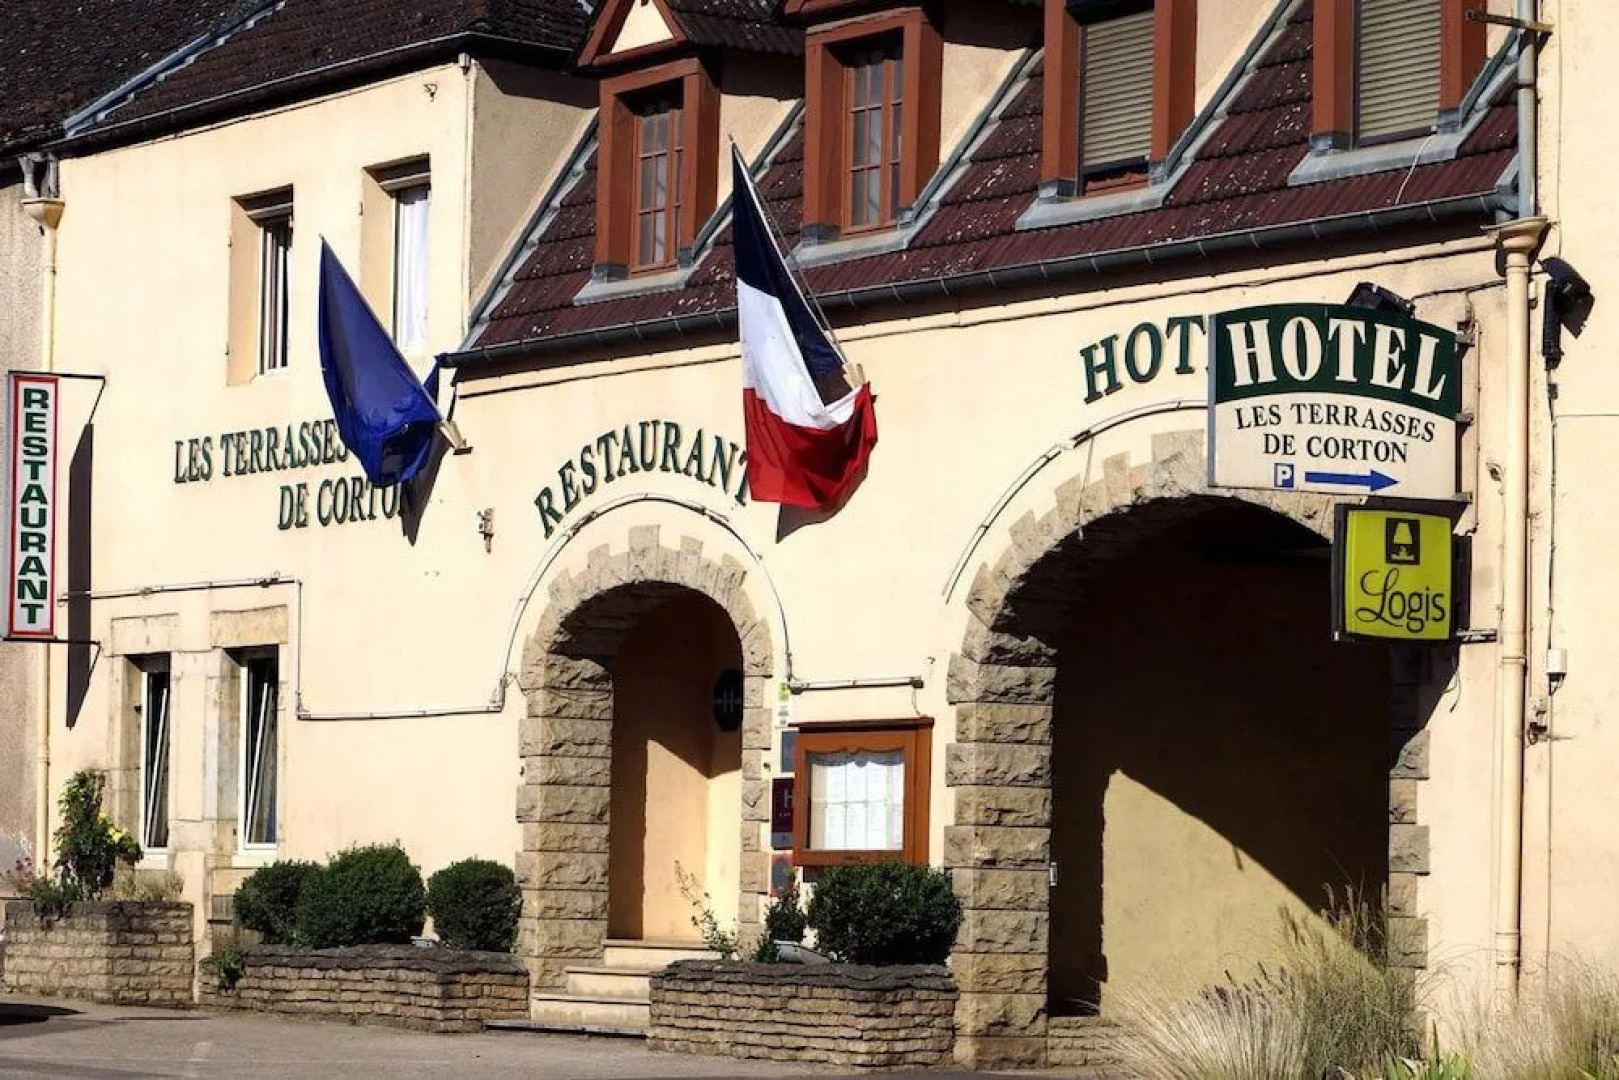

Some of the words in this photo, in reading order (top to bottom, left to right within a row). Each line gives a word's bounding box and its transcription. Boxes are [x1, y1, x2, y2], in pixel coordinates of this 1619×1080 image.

[1079, 315, 1209, 404] HOT
[1225, 315, 1447, 401] HOTEL
[1235, 404, 1283, 430] LES
[1290, 402, 1436, 443] TERRASSES
[1262, 433, 1297, 456] DE
[1306, 436, 1408, 463] CORTON
[174, 435, 214, 484] LES
[533, 418, 750, 540] RESTAURANT
[1277, 465, 1293, 487] P
[17, 388, 49, 624] RESTAURANT
[278, 482, 310, 531] DE
[318, 476, 404, 527] CORTO
[1354, 567, 1446, 633] Logis
